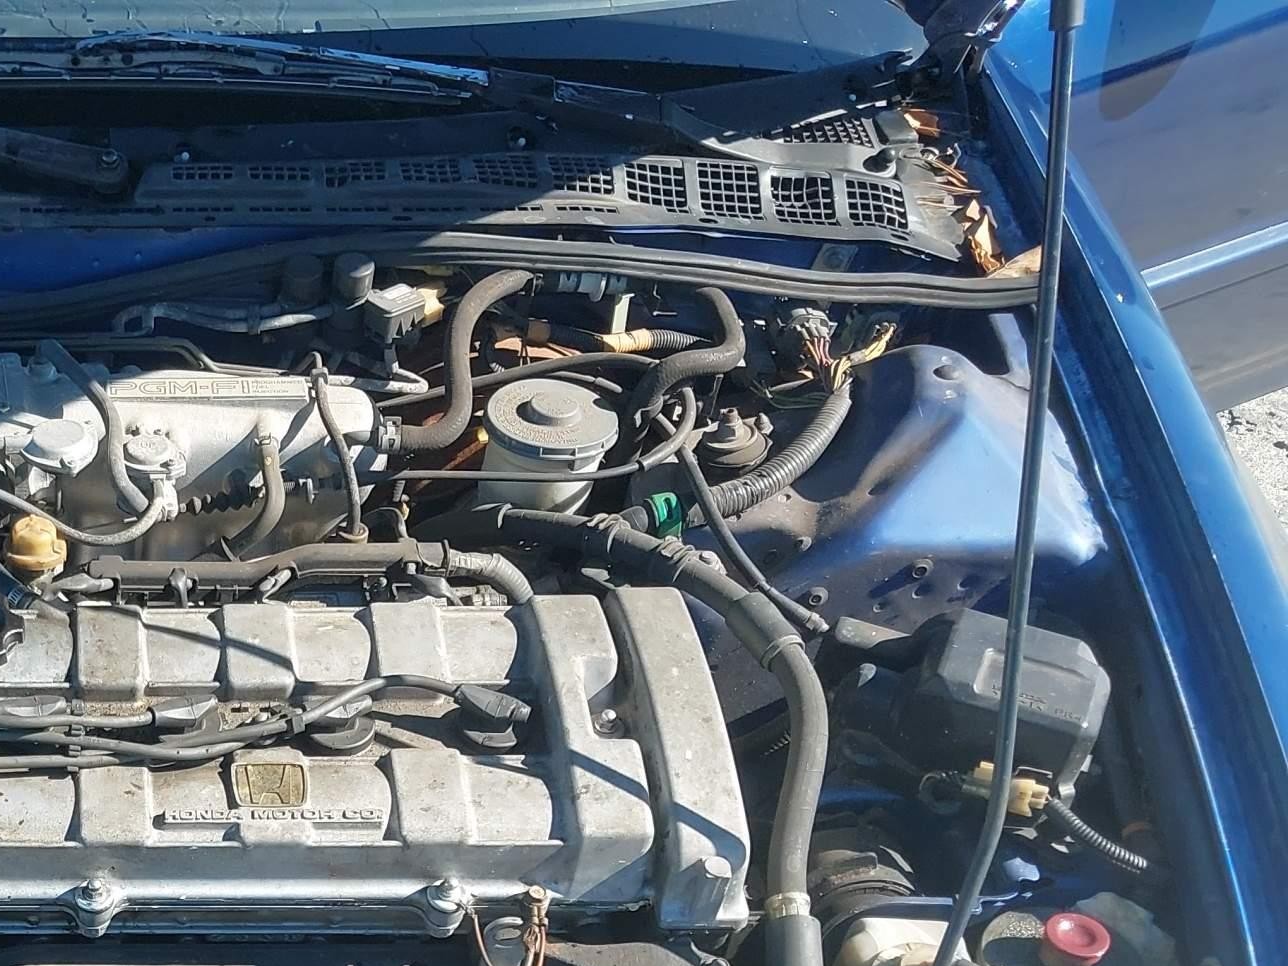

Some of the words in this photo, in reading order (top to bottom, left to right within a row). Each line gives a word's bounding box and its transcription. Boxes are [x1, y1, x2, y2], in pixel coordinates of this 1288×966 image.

[112, 380, 251, 395] PGM-FI
[164, 808, 244, 821] HONDA
[250, 808, 336, 821] MOTOR
